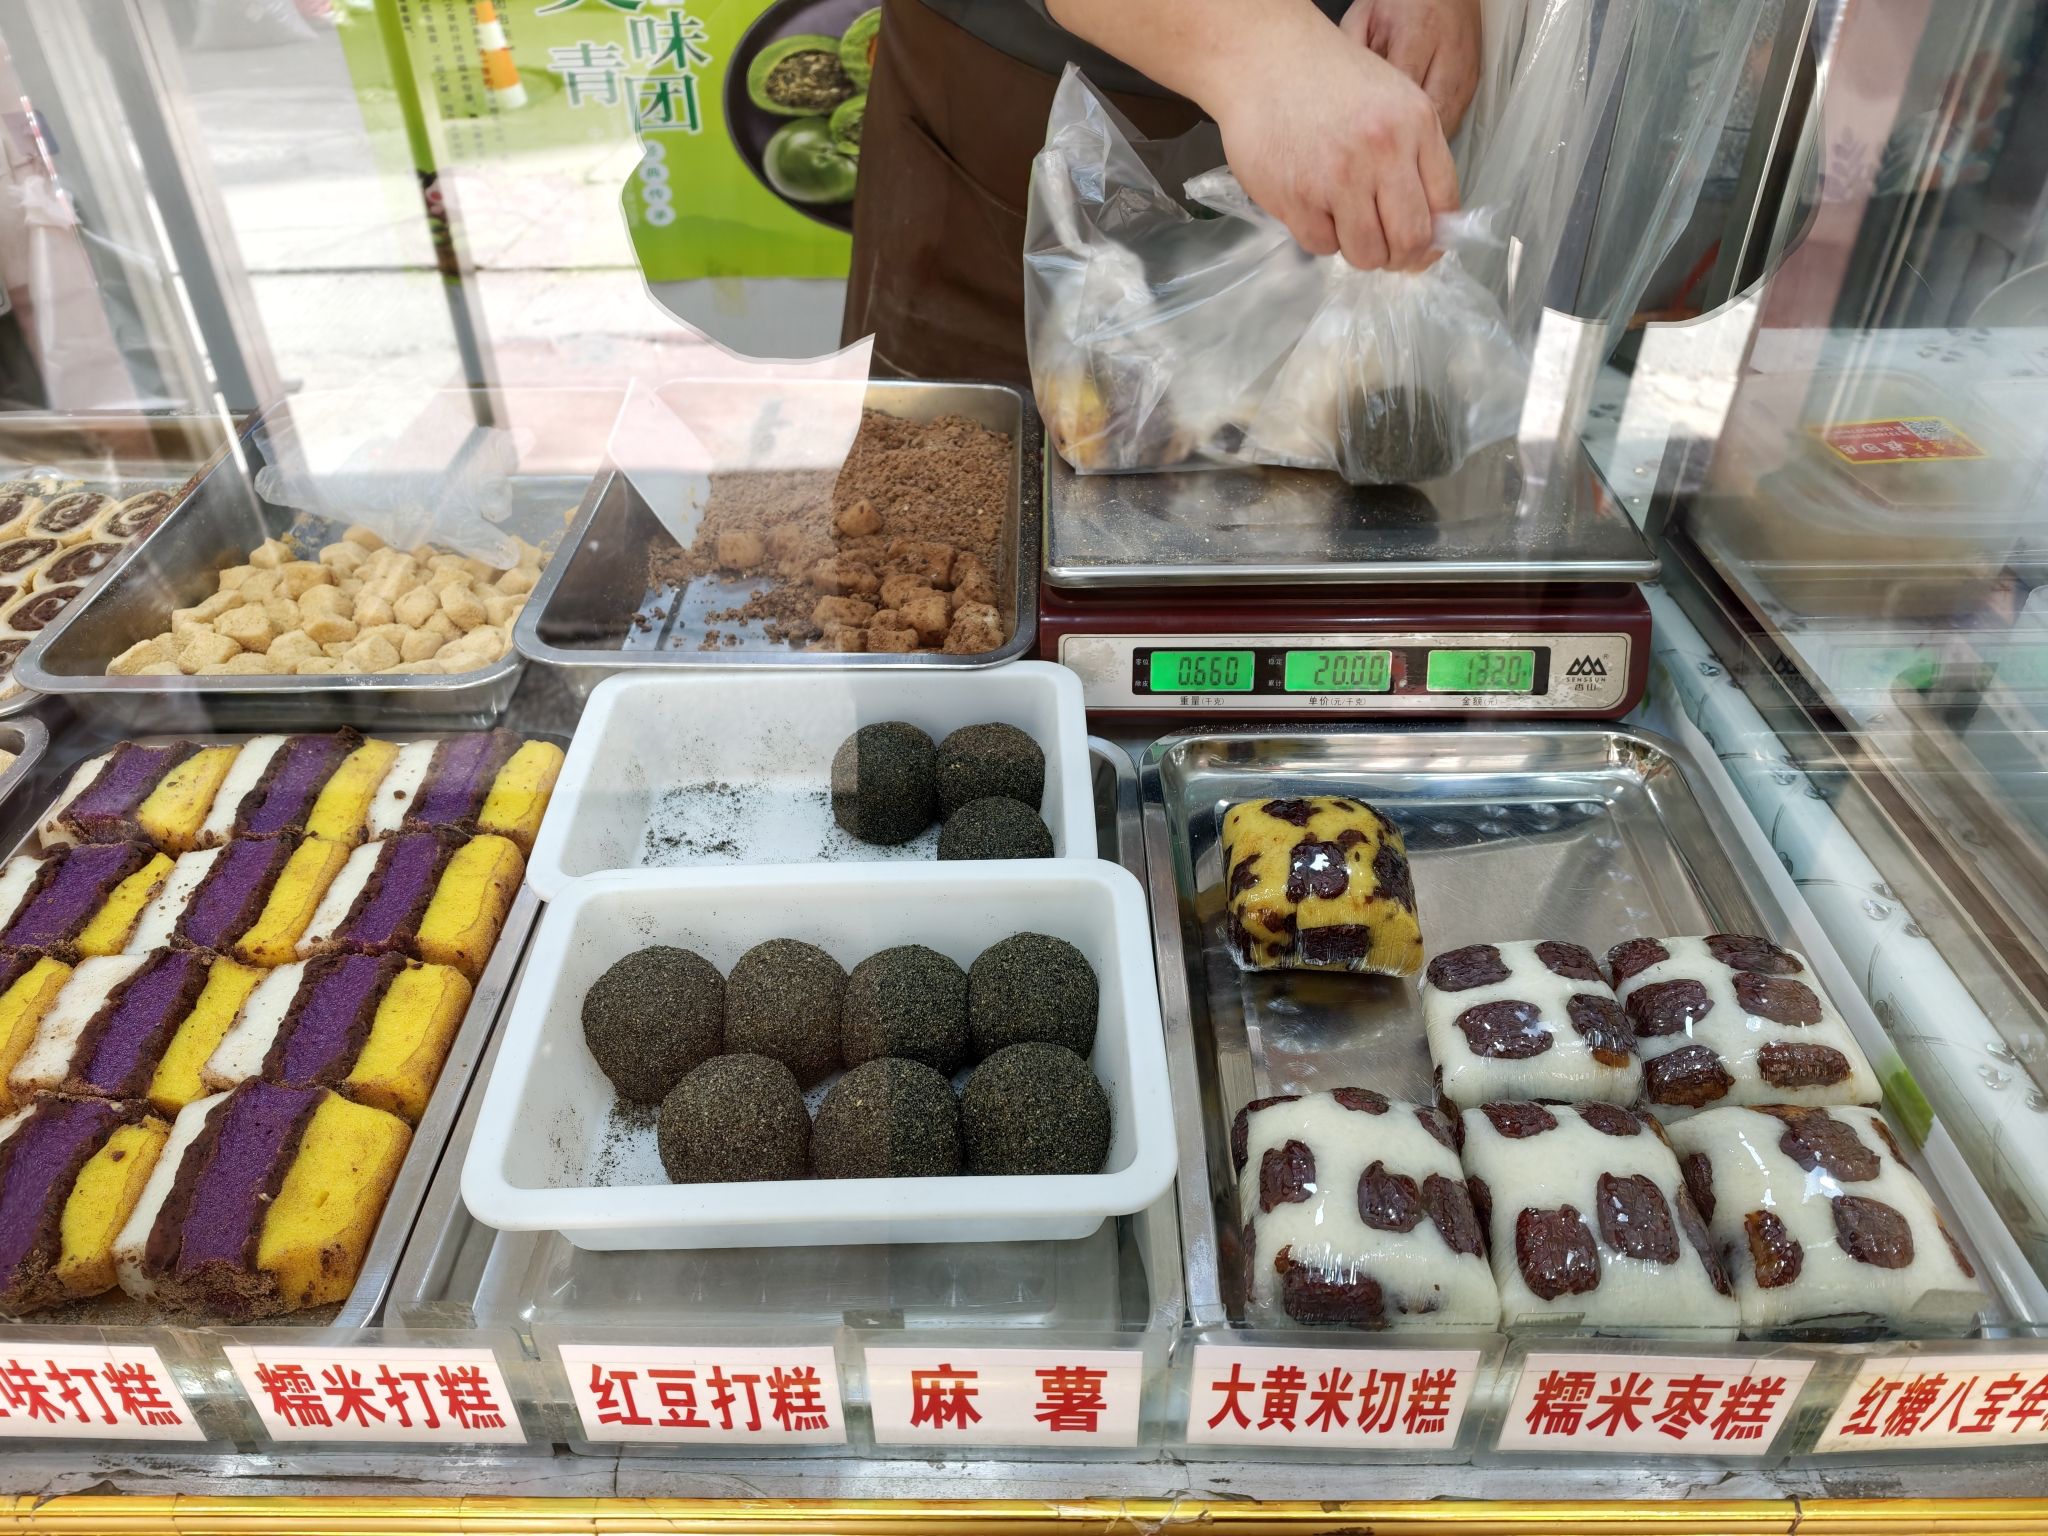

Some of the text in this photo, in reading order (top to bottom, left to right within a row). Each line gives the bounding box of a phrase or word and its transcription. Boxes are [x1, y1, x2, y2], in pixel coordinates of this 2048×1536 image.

[1178, 656, 1239, 686] 0.660
[1313, 655, 1385, 686] 20.00
[0, 1359, 182, 1426] 味打糕
[257, 1362, 506, 1429] 糯米打糕
[589, 1363, 829, 1432] 红豆打糕
[1207, 1363, 1457, 1434] 大黄米切糕
[1526, 1369, 1786, 1441] 糯米枣糕
[1839, 1372, 2048, 1437] 红糖八宝年
